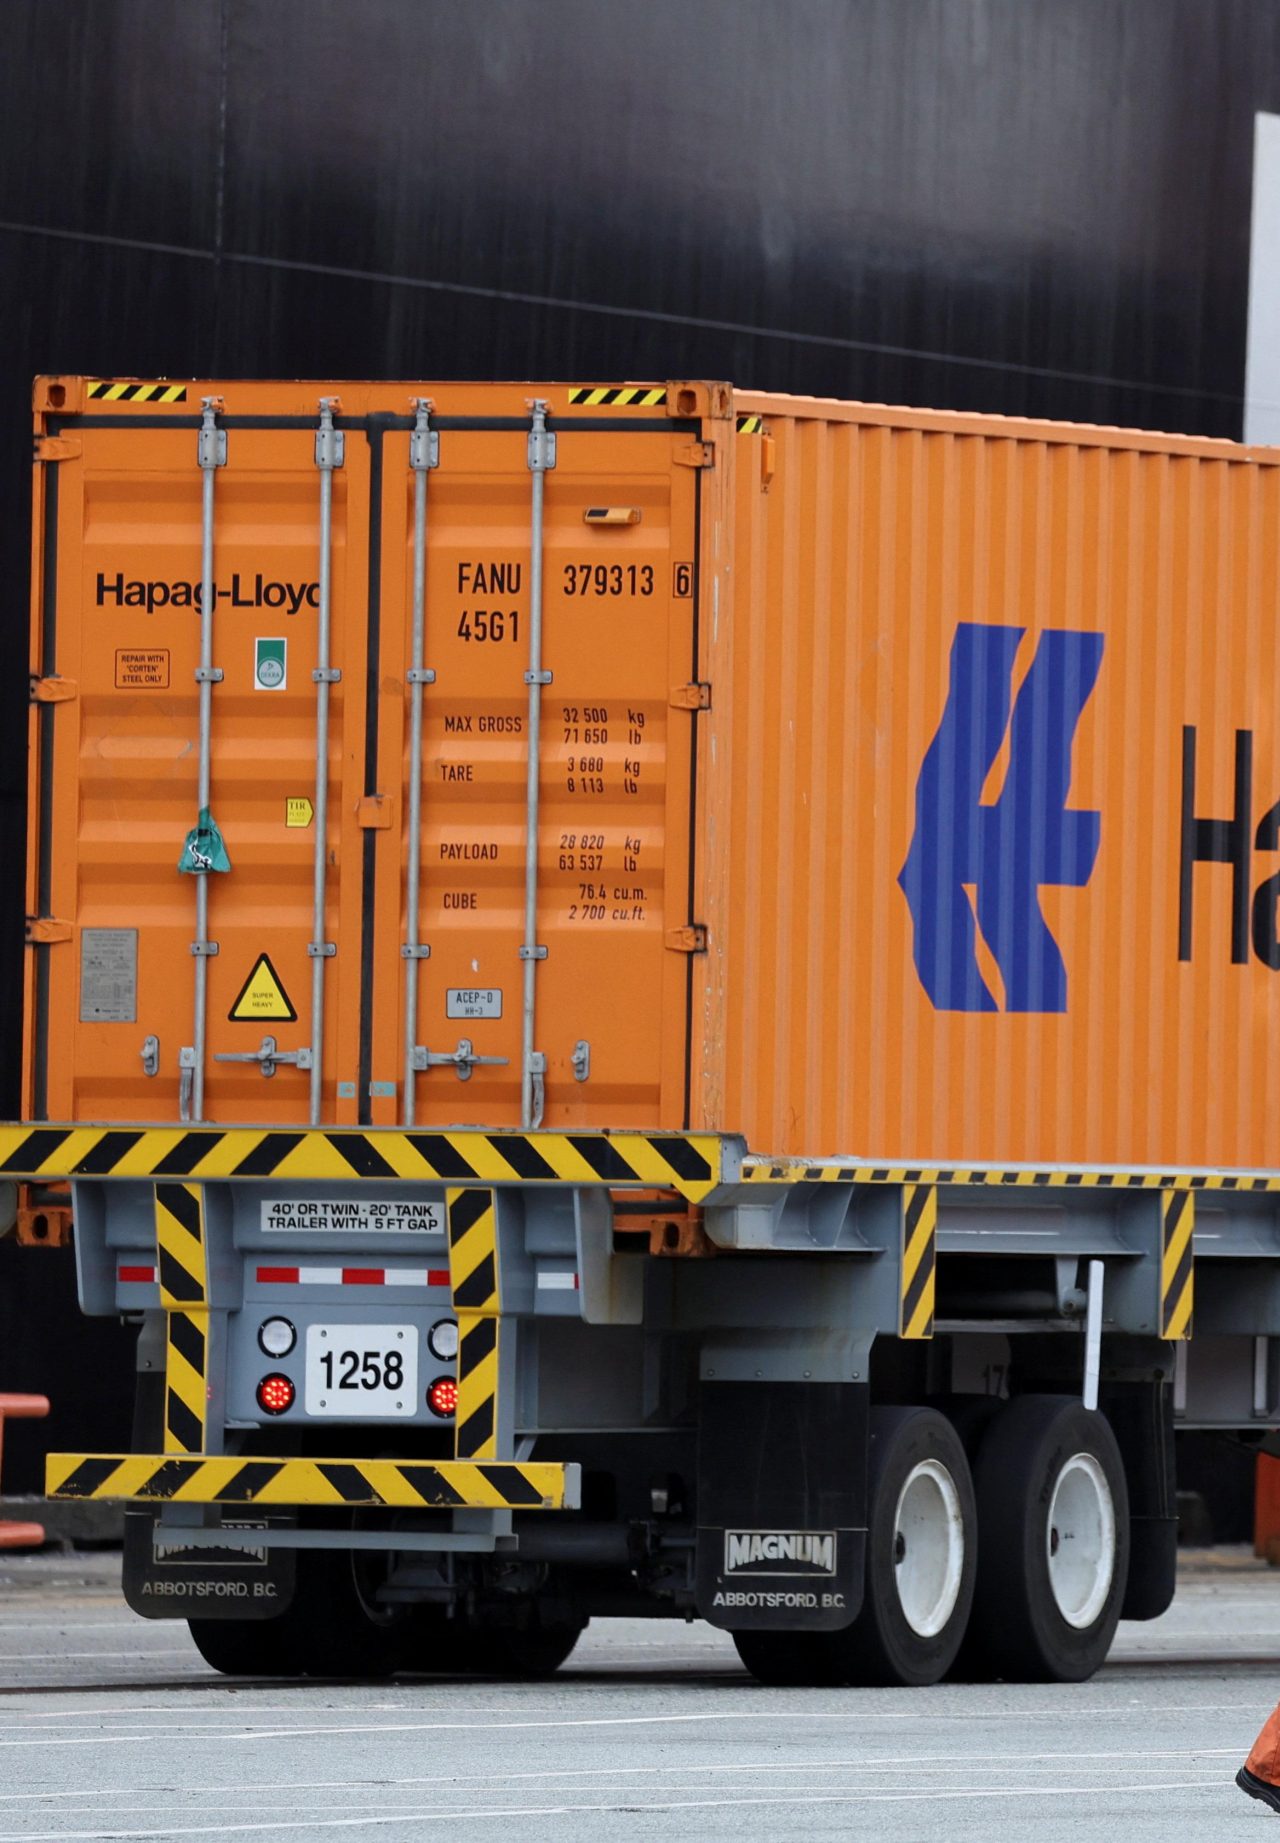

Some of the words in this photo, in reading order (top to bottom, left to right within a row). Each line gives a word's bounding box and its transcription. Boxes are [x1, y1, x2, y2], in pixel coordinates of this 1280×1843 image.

[457, 563, 521, 594] FANU
[563, 565, 654, 596] 379313
[676, 566, 690, 596] 6
[457, 611, 518, 642] 45G1
[121, 654, 145, 663] REPAIR
[147, 655, 164, 663] WITH
[123, 675, 143, 683] STEEL
[144, 675, 162, 683] ONLY
[445, 716, 472, 732] MAX
[478, 716, 522, 732] GROSS
[563, 708, 579, 723] 32
[584, 708, 608, 723] 500
[628, 709, 645, 727] kg
[564, 728, 579, 743] 71
[584, 728, 608, 744] 650
[629, 729, 642, 745] lb
[441, 764, 473, 782] TARE
[580, 757, 604, 773] 680
[624, 758, 640, 777] kg
[581, 778, 604, 793] 113
[624, 778, 638, 794] lb
[440, 843, 498, 860] PAYLOAD
[560, 834, 576, 850] 28
[580, 835, 605, 850] 820
[625, 836, 641, 855] kg
[559, 855, 575, 871] 63
[580, 855, 603, 871] 537
[624, 856, 637, 872] lb
[443, 893, 477, 909] CUBE
[579, 884, 606, 900] 76.4
[581, 905, 606, 920] 700
[272, 1203, 295, 1215] 40'
[297, 1203, 318, 1215] OR
[321, 1204, 360, 1215] TWIN
[369, 1204, 392, 1216] 20'
[395, 1205, 433, 1217] TANK
[268, 1217, 328, 1230] TRAILER
[332, 1218, 368, 1230] WITH
[375, 1218, 384, 1230] 5
[387, 1219, 405, 1230] FT
[407, 1219, 438, 1231] GAP
[320, 1350, 404, 1391] 1258
[729, 1534, 833, 1571] MAGNUM
